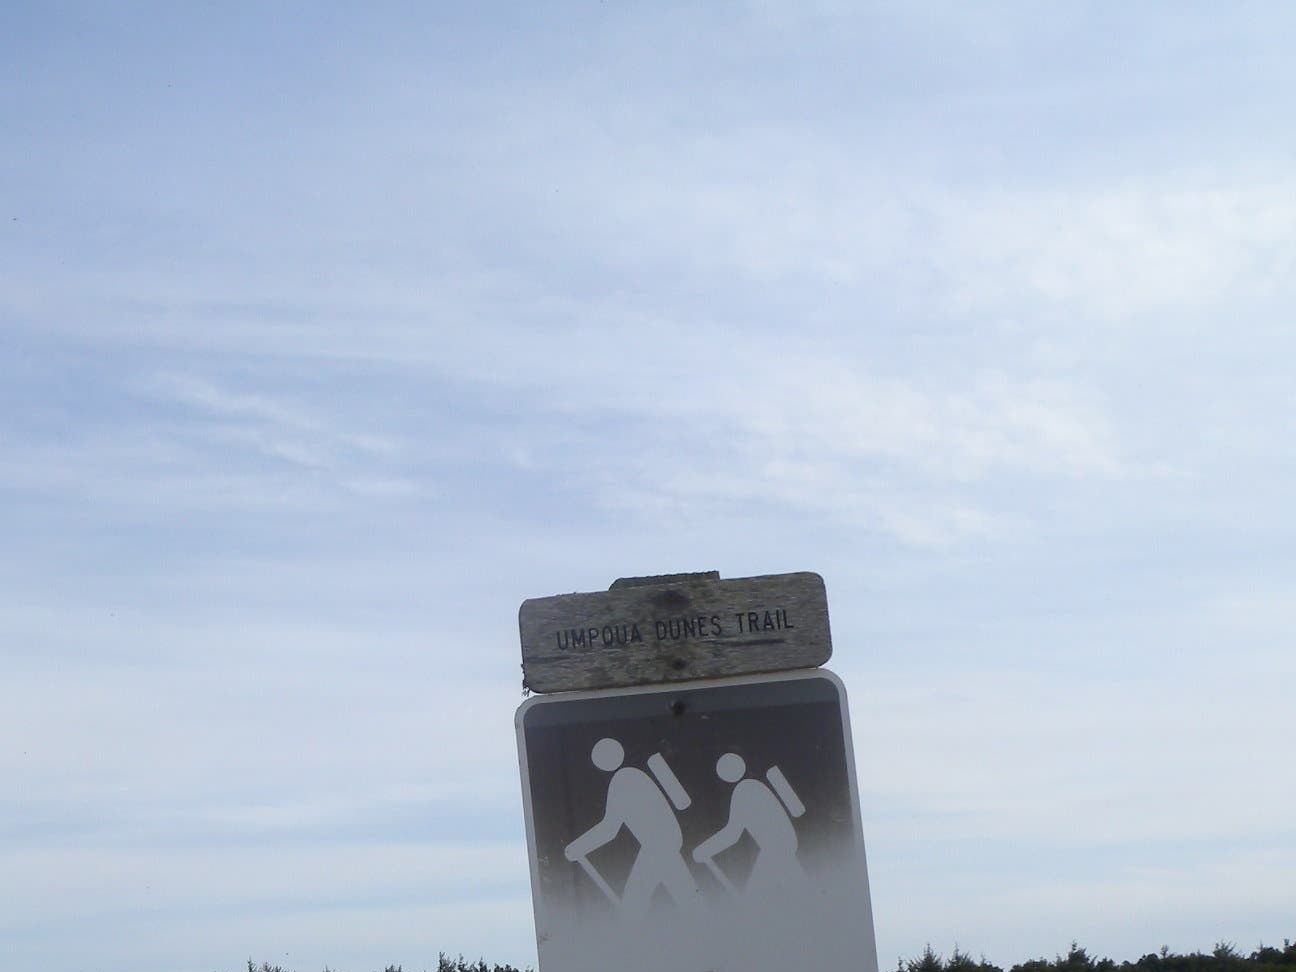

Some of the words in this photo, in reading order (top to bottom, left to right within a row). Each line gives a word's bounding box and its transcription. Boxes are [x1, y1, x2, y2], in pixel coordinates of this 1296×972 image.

[556, 623, 642, 650] UMPQUA
[655, 615, 723, 641] DUNES
[735, 609, 795, 633] TRAIL
